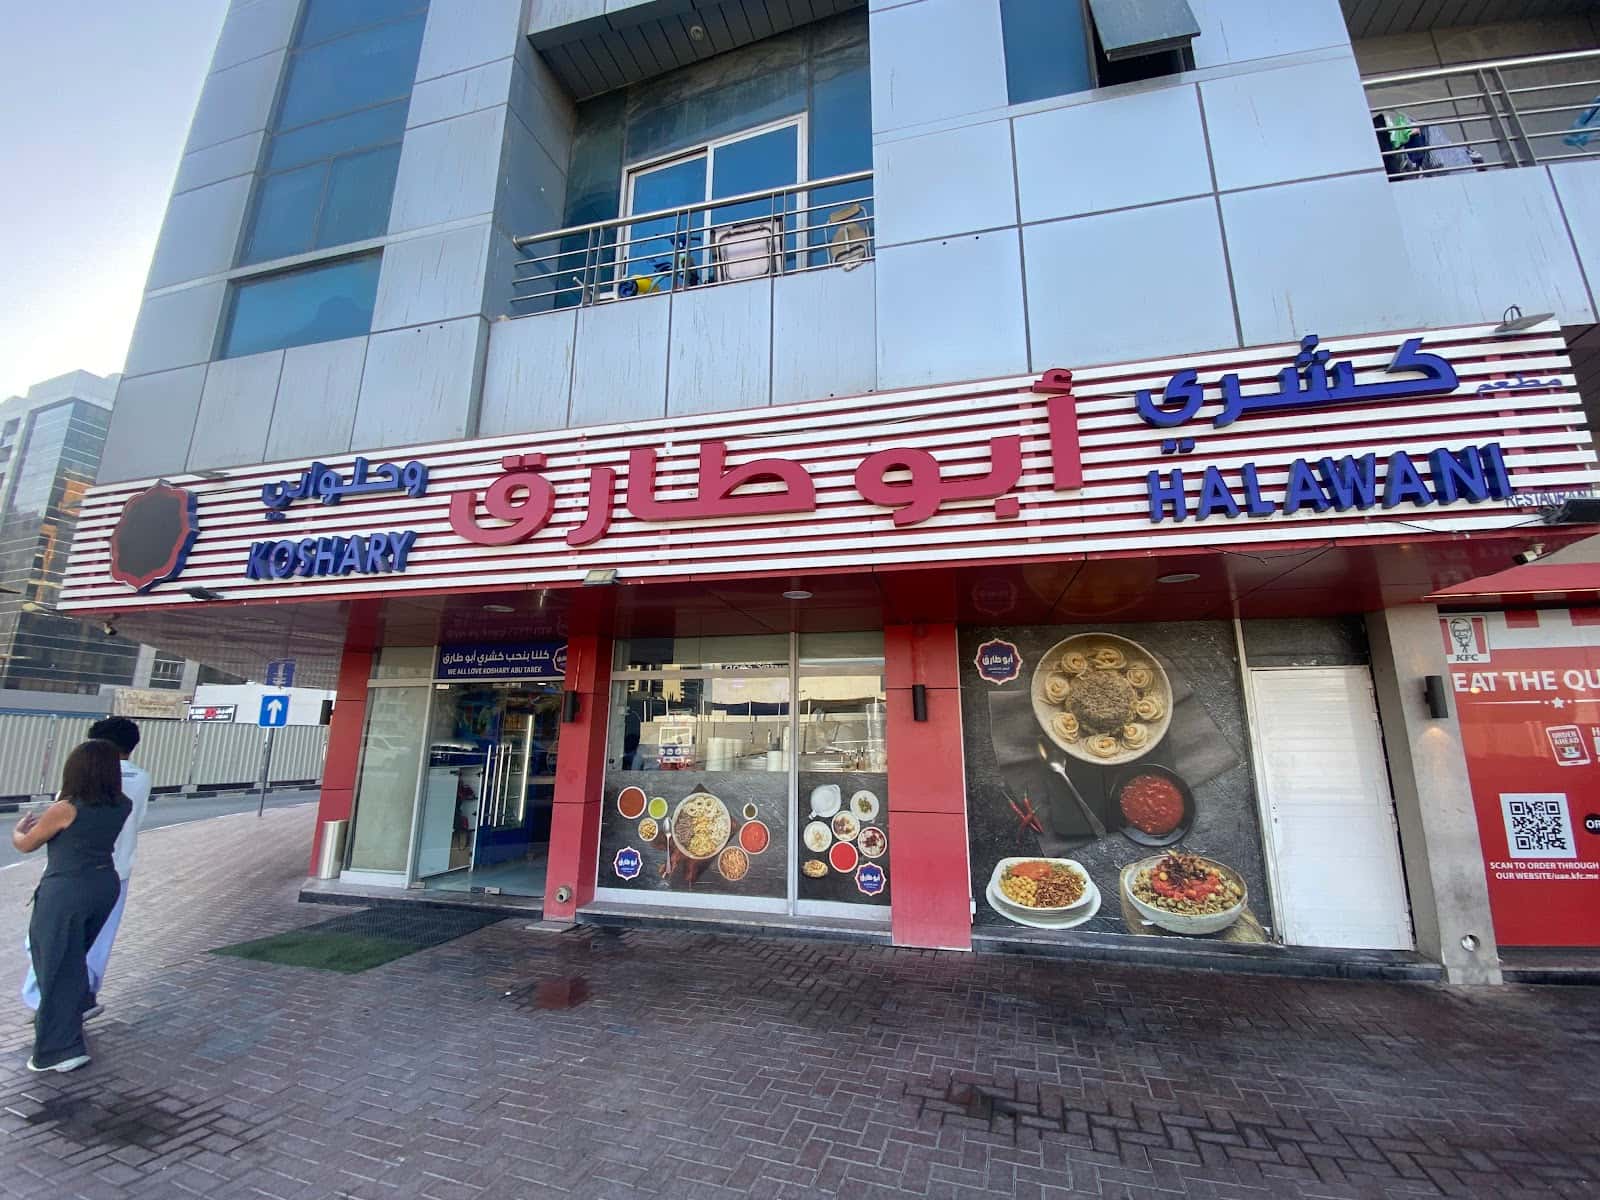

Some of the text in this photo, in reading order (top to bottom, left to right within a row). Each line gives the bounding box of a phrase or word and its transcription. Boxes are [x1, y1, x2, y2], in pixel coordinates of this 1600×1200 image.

[1477, 373, 1562, 399] مطعم
[855, 368, 1083, 527] أبو
[1147, 442, 1513, 523] HALAWANI
[449, 441, 816, 547] طارق
[246, 530, 417, 580] KOSHARY
[442, 652, 464, 665] طارق
[464, 649, 477, 664] أبو
[505, 650, 530, 662] بنحب
[531, 649, 550, 660] كلنا
[1456, 653, 1478, 662] KFC
[457, 667, 467, 675] ALL
[467, 667, 482, 675] LOVE
[482, 666, 510, 674] KOSHARY
[510, 666, 523, 674] ABU
[523, 665, 542, 673] TAREK
[1452, 672, 1498, 692] EAT
[1502, 671, 1558, 691] THE
[1557, 861, 1599, 869] THROUGH
[1495, 872, 1515, 880] OUR
